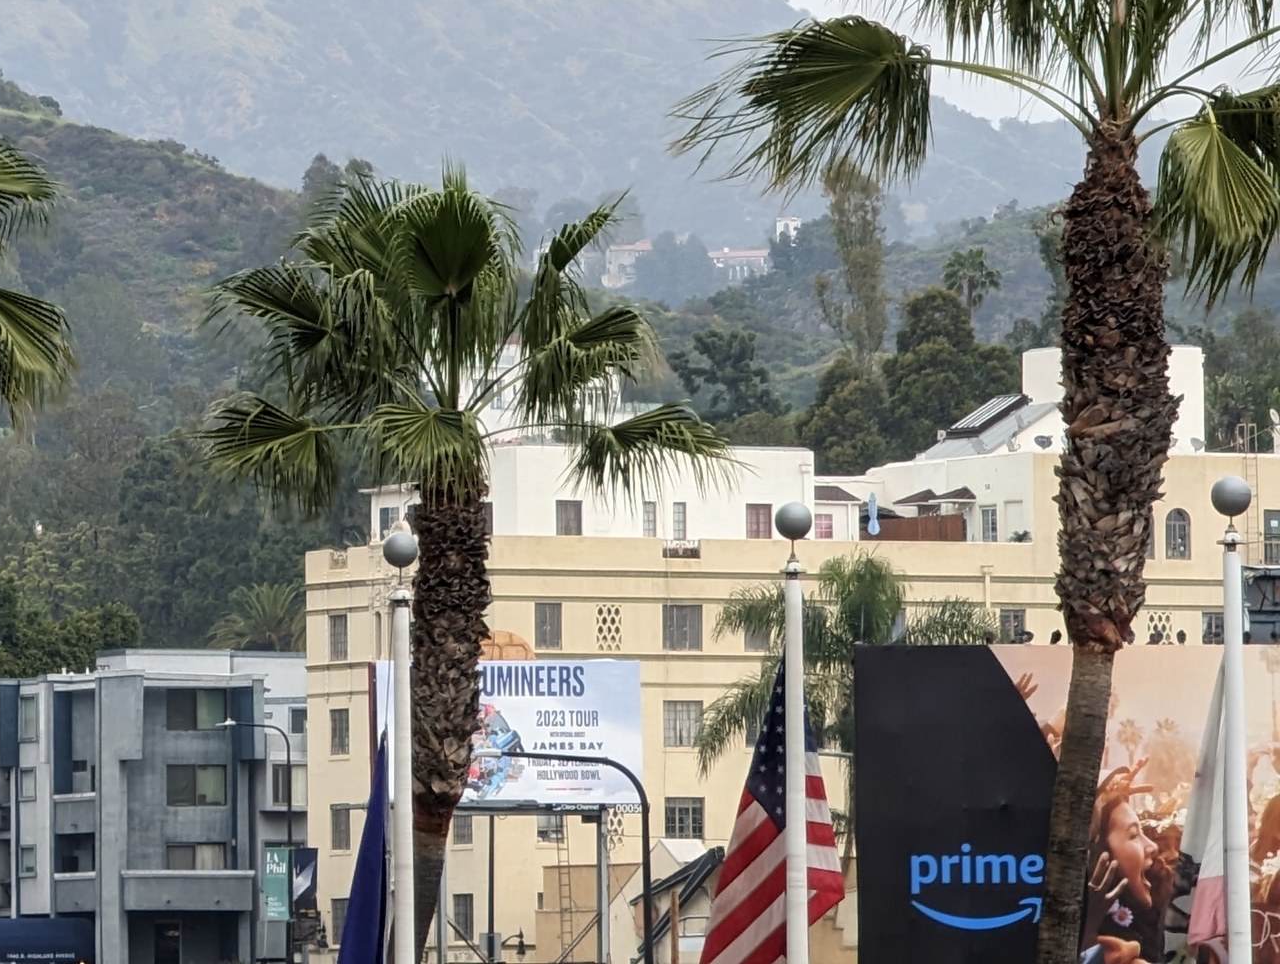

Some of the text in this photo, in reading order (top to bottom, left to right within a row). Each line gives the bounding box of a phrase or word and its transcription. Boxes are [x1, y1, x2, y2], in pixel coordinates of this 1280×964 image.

[536, 710, 599, 727] 2023 TOUR
[532, 742, 603, 750] JAMES BAY
[537, 770, 601, 780] HOLLYWOOD BOWL
[266, 862, 286, 874] Phil
[911, 843, 1044, 895] prime
